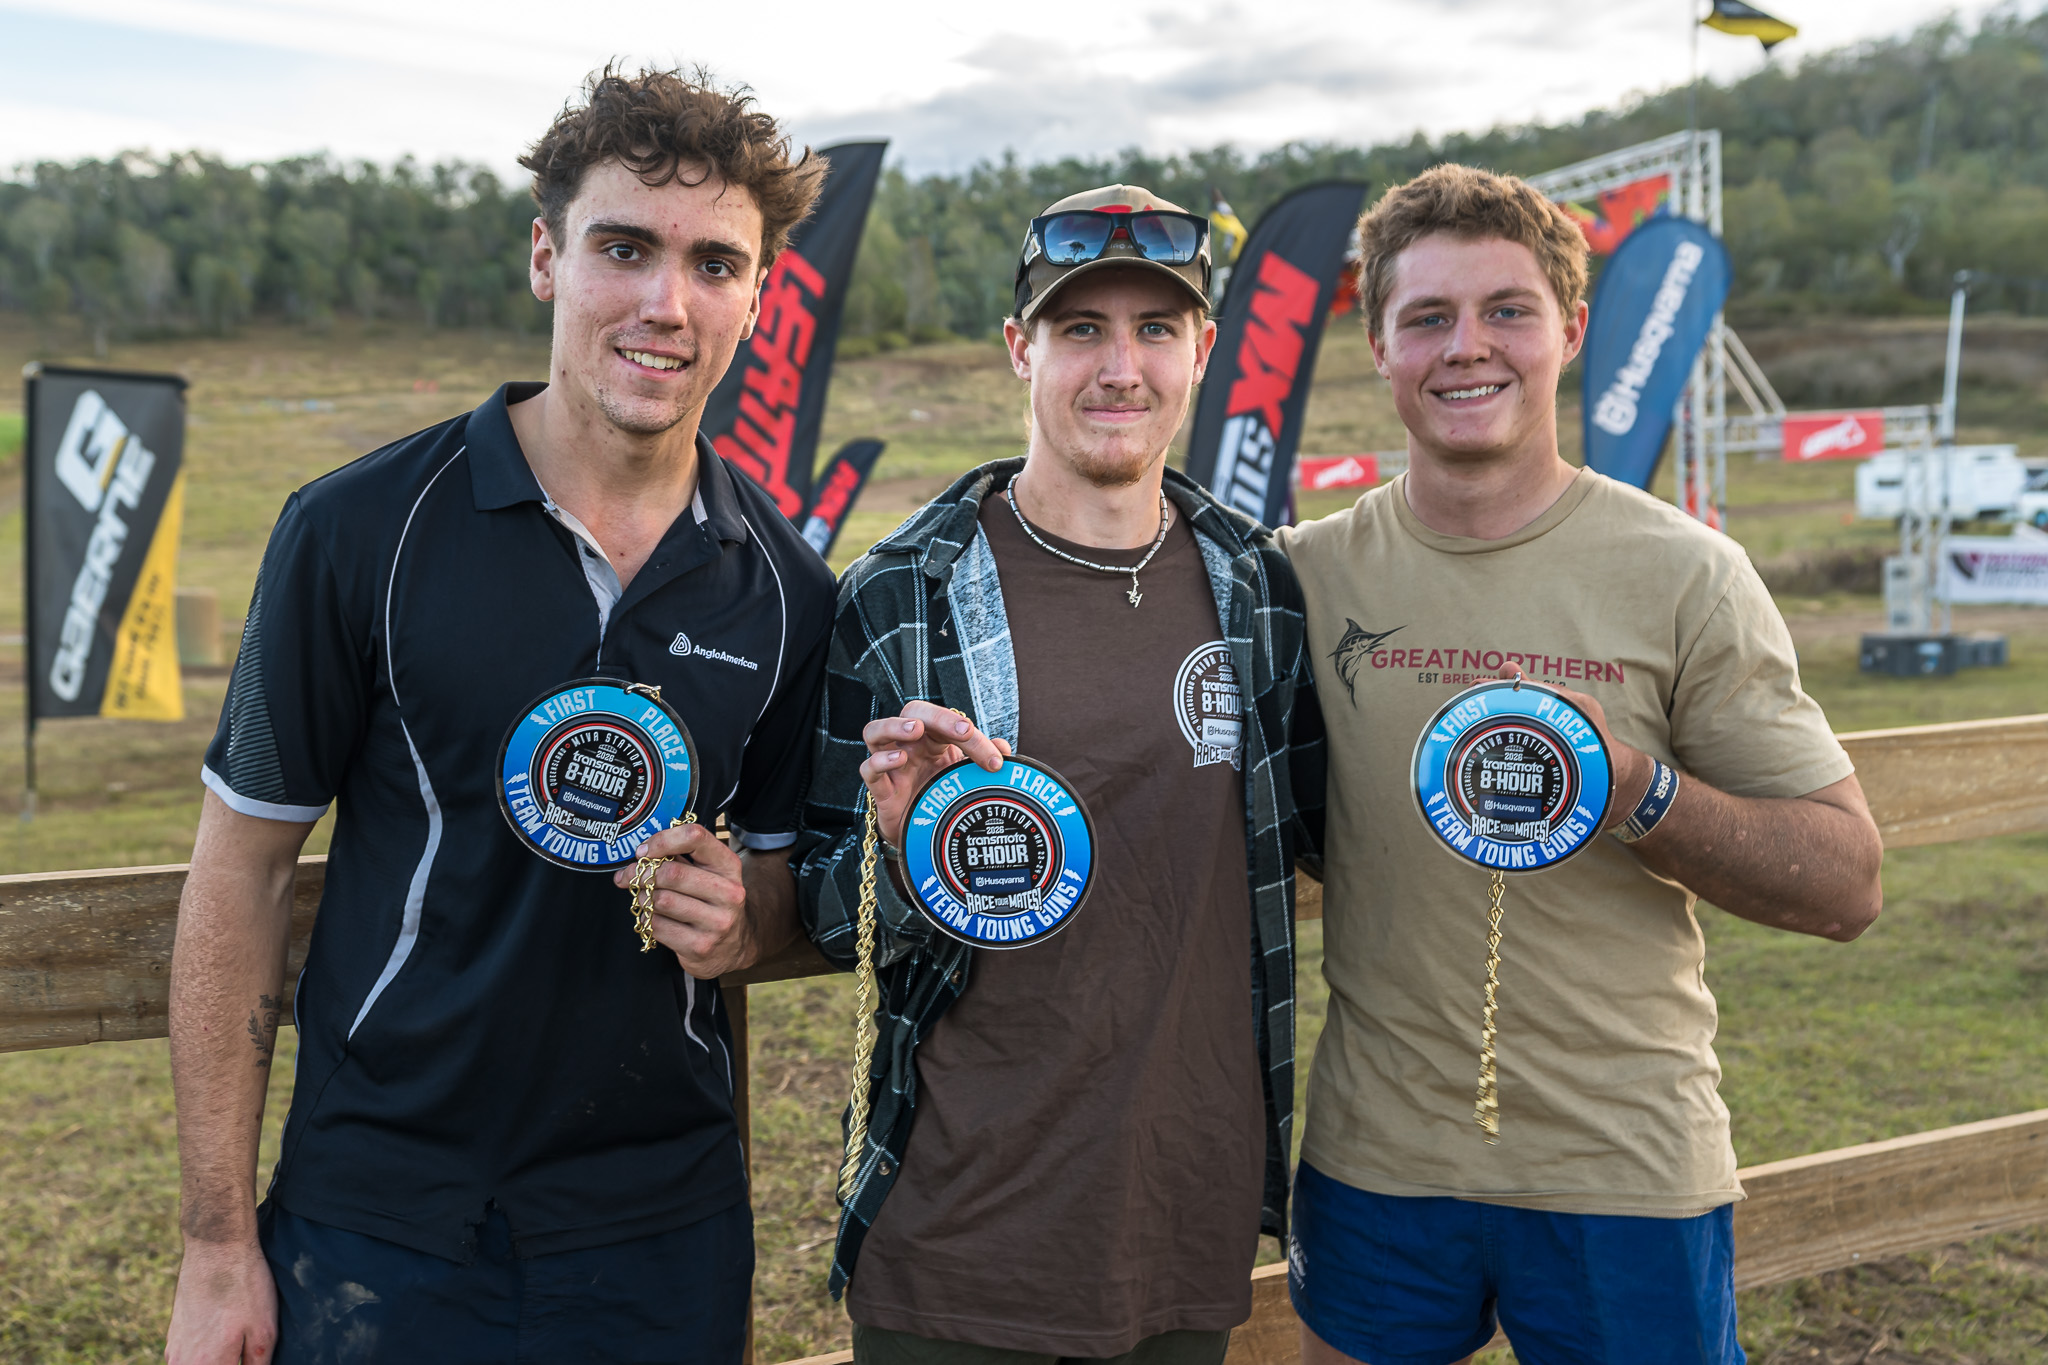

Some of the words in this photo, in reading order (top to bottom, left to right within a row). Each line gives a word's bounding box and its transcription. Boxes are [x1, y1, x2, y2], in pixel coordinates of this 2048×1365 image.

[1226, 250, 1320, 440] MX
[1418, 672, 1439, 683] EST
[1201, 692, 1243, 716] 8-HOU
[543, 689, 596, 723] FIRST
[638, 707, 686, 760] PLACE
[1440, 696, 1489, 736] FIRST
[1536, 697, 1592, 745] PLACE
[605, 733, 643, 767] STATION
[1194, 741, 1221, 768] RACE
[1509, 733, 1553, 760] STATION
[573, 750, 631, 778] transmoto
[1482, 757, 1545, 773] transmoto
[565, 762, 628, 797] 8-HOUR
[920, 772, 966, 818] FIRST
[1010, 766, 1066, 809] PLACE
[1480, 770, 1543, 793] 8-HOUR
[571, 795, 612, 814] Husqvarna
[987, 806, 1033, 829] STATION
[1494, 802, 1536, 813] Husqvarna
[508, 784, 546, 835] TEAM
[540, 828, 599, 864] YOUNG
[606, 826, 652, 861] GUNS
[543, 801, 574, 826] RACE
[573, 817, 586, 828] YOUR
[585, 819, 622, 846] MATES!
[1431, 803, 1472, 851] TEAM
[1475, 839, 1537, 867] YOUNG
[1540, 816, 1588, 860] GUNS
[1471, 813, 1500, 837] RACE
[1500, 824, 1515, 832] YOUR
[1515, 819, 1551, 843] MATES!
[966, 832, 1027, 846] transmoto
[967, 844, 1029, 866] 8-HOUR
[984, 876, 1025, 885] Husqvarna
[926, 886, 973, 932] TEAM
[976, 917, 1036, 941] YOUNG
[1041, 881, 1079, 927] GUNS
[965, 892, 996, 916] RACE
[995, 897, 1009, 906] YOUR
[1008, 886, 1043, 912] MATES!
